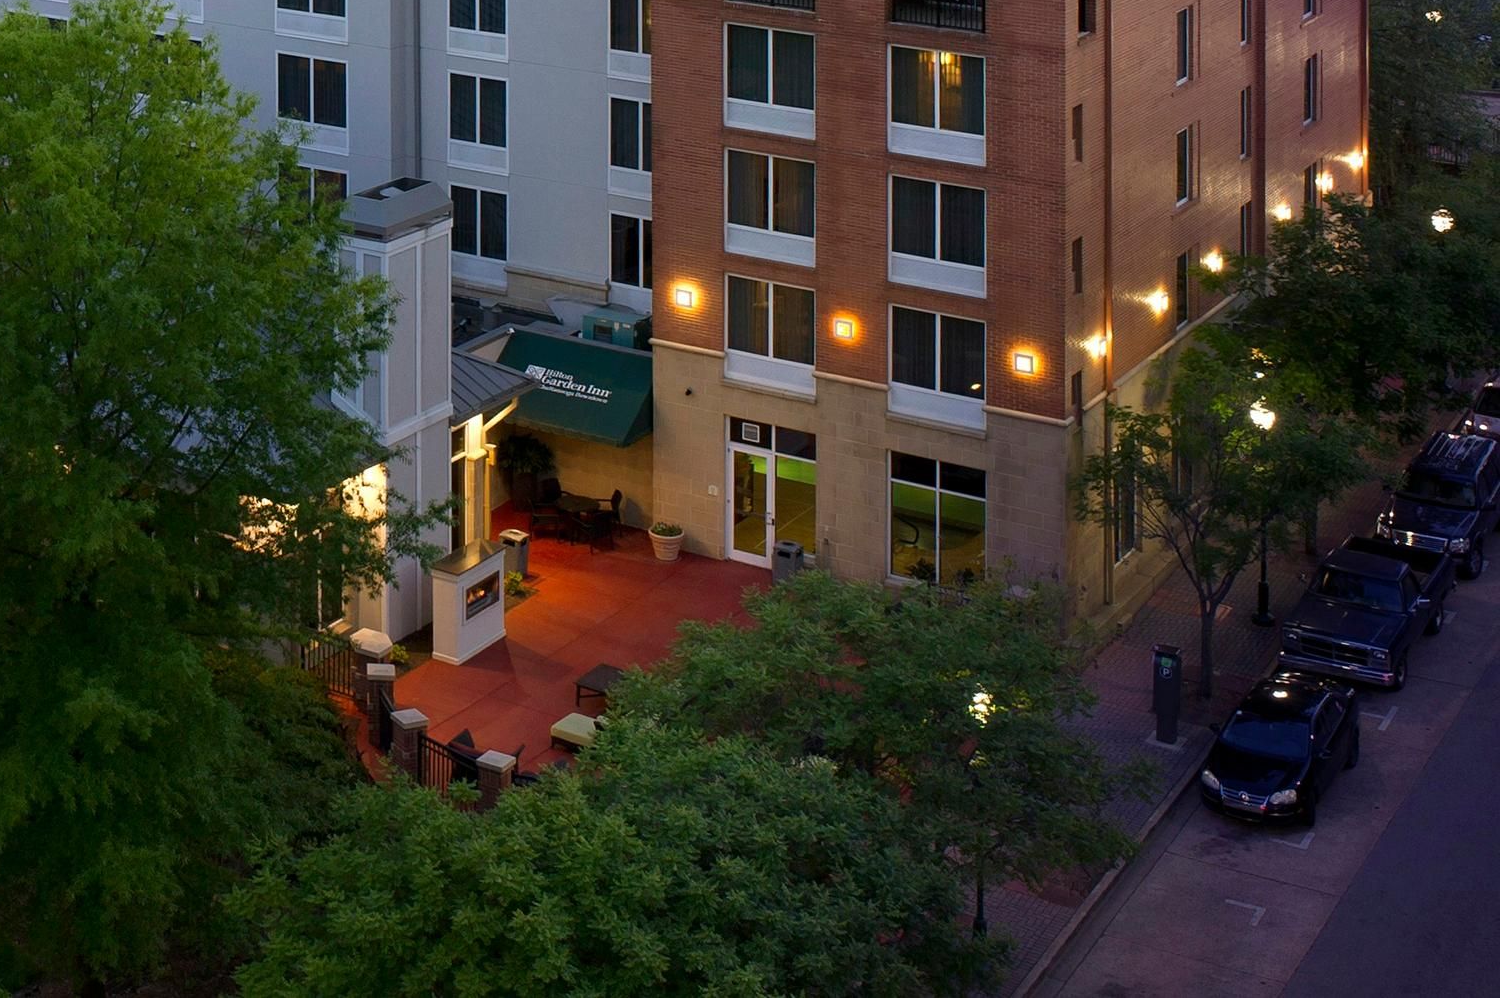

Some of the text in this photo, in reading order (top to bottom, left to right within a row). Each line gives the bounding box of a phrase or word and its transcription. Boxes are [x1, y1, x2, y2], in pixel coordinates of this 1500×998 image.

[545, 368, 574, 381] Hilton
[541, 375, 611, 398] Garden Inn
[1162, 667, 1170, 676] P
